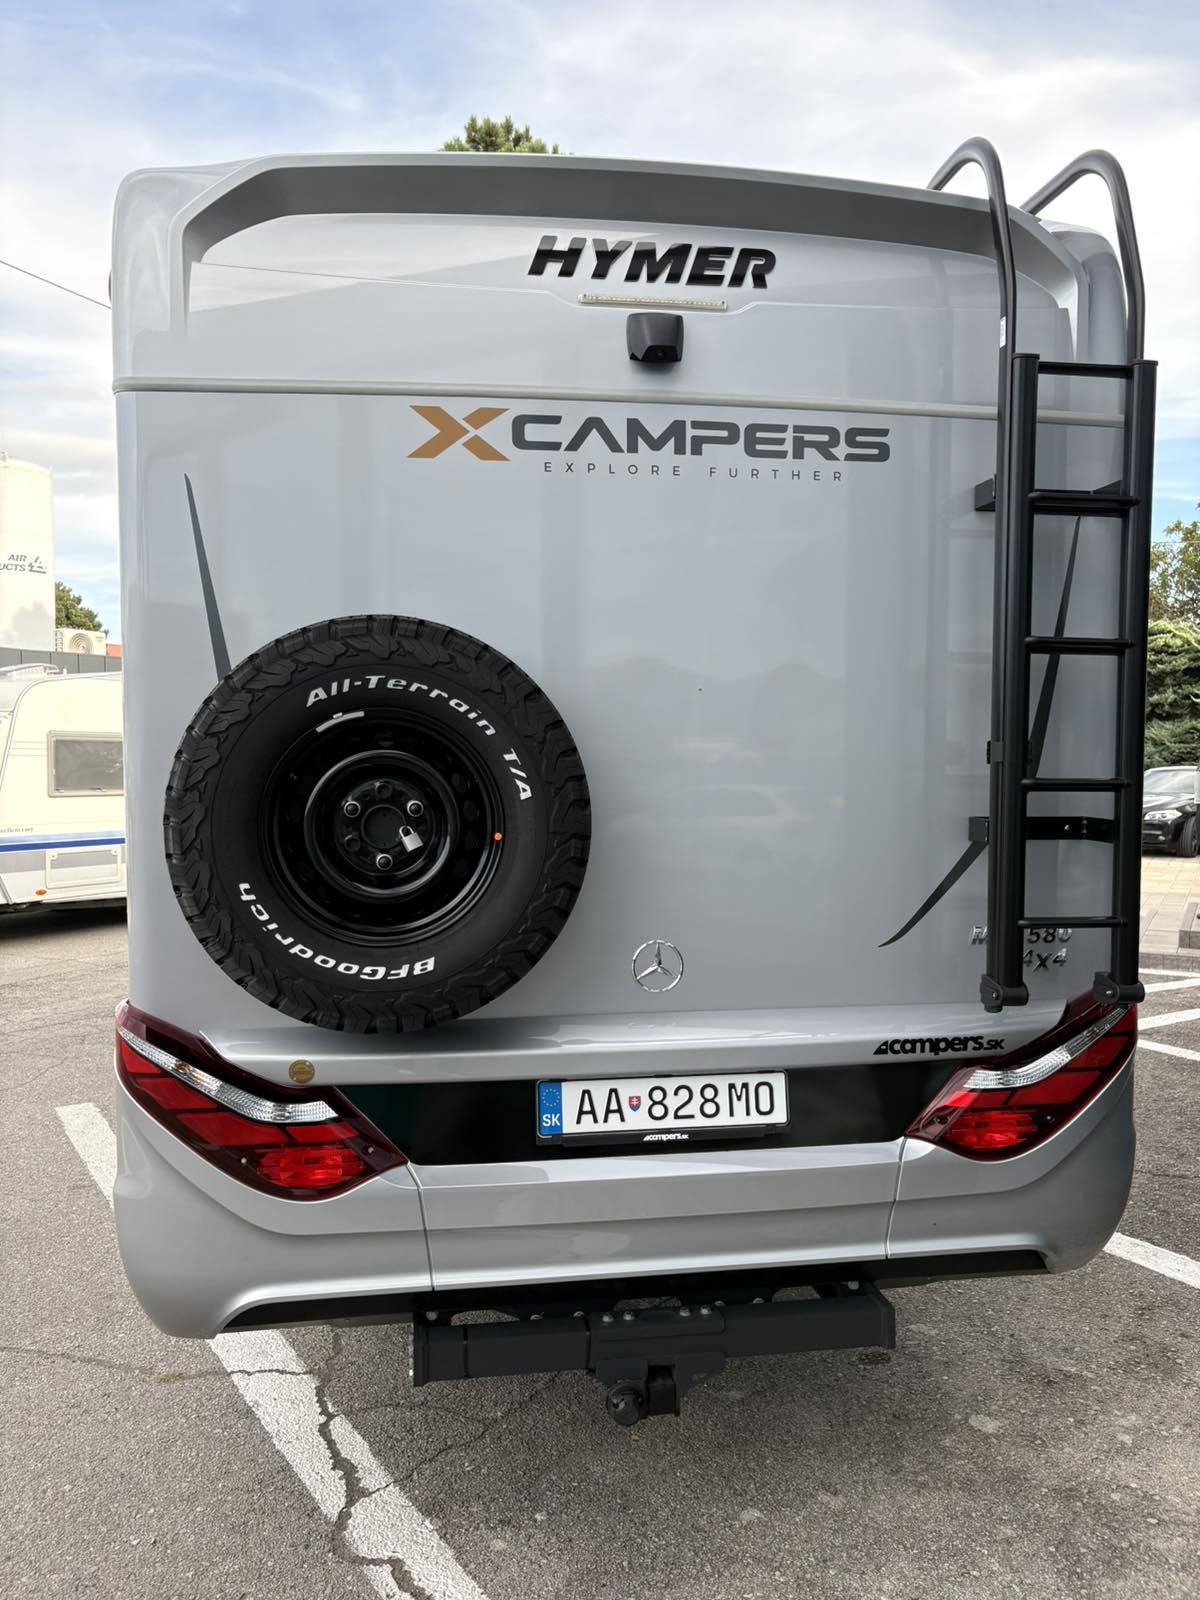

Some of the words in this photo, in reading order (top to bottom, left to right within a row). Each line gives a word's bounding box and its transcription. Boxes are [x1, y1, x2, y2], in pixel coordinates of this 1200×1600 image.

[528, 235, 777, 289] HYMER
[544, 461, 681, 477] EXPLORE
[708, 466, 843, 482] FURTHER
[8, 554, 27, 562] AIR
[306, 675, 496, 736] All-Terrain
[503, 748, 533, 800] T/A
[238, 882, 436, 980] BFGoodrich
[542, 1113, 562, 1127] SK
[576, 1087, 626, 1125] AA
